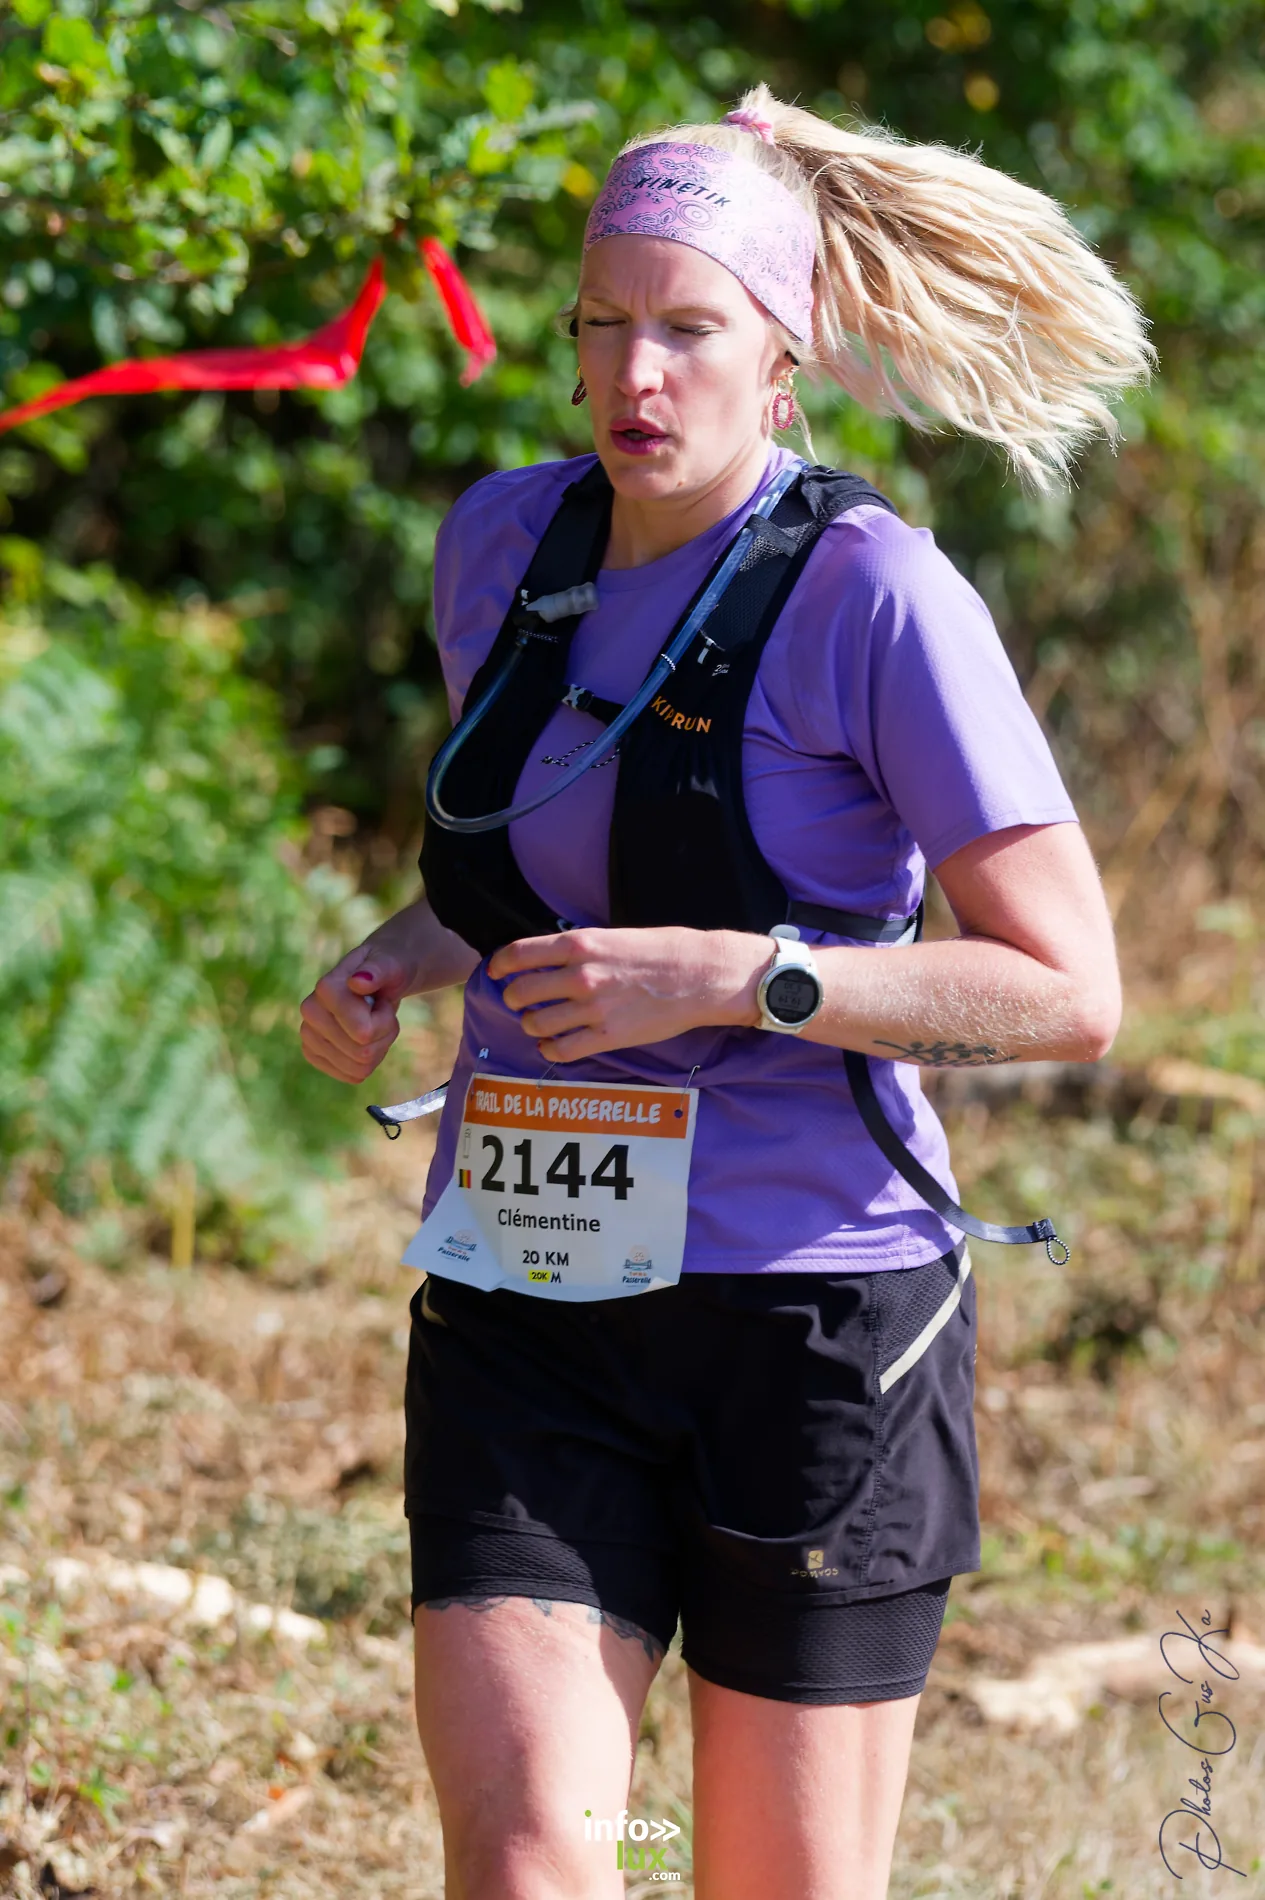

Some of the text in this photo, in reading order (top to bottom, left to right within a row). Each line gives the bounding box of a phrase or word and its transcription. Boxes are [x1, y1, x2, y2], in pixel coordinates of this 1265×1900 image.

[633, 177, 732, 208] KINETIK
[651, 695, 712, 733] KIPRUN
[475, 1090, 662, 1124] TRAIL DE LA PASSERELLE
[481, 1133, 635, 1200] 2144
[498, 1208, 601, 1233] Clémentine
[522, 1249, 569, 1266] 20 KM
[531, 1271, 548, 1280] 20K
